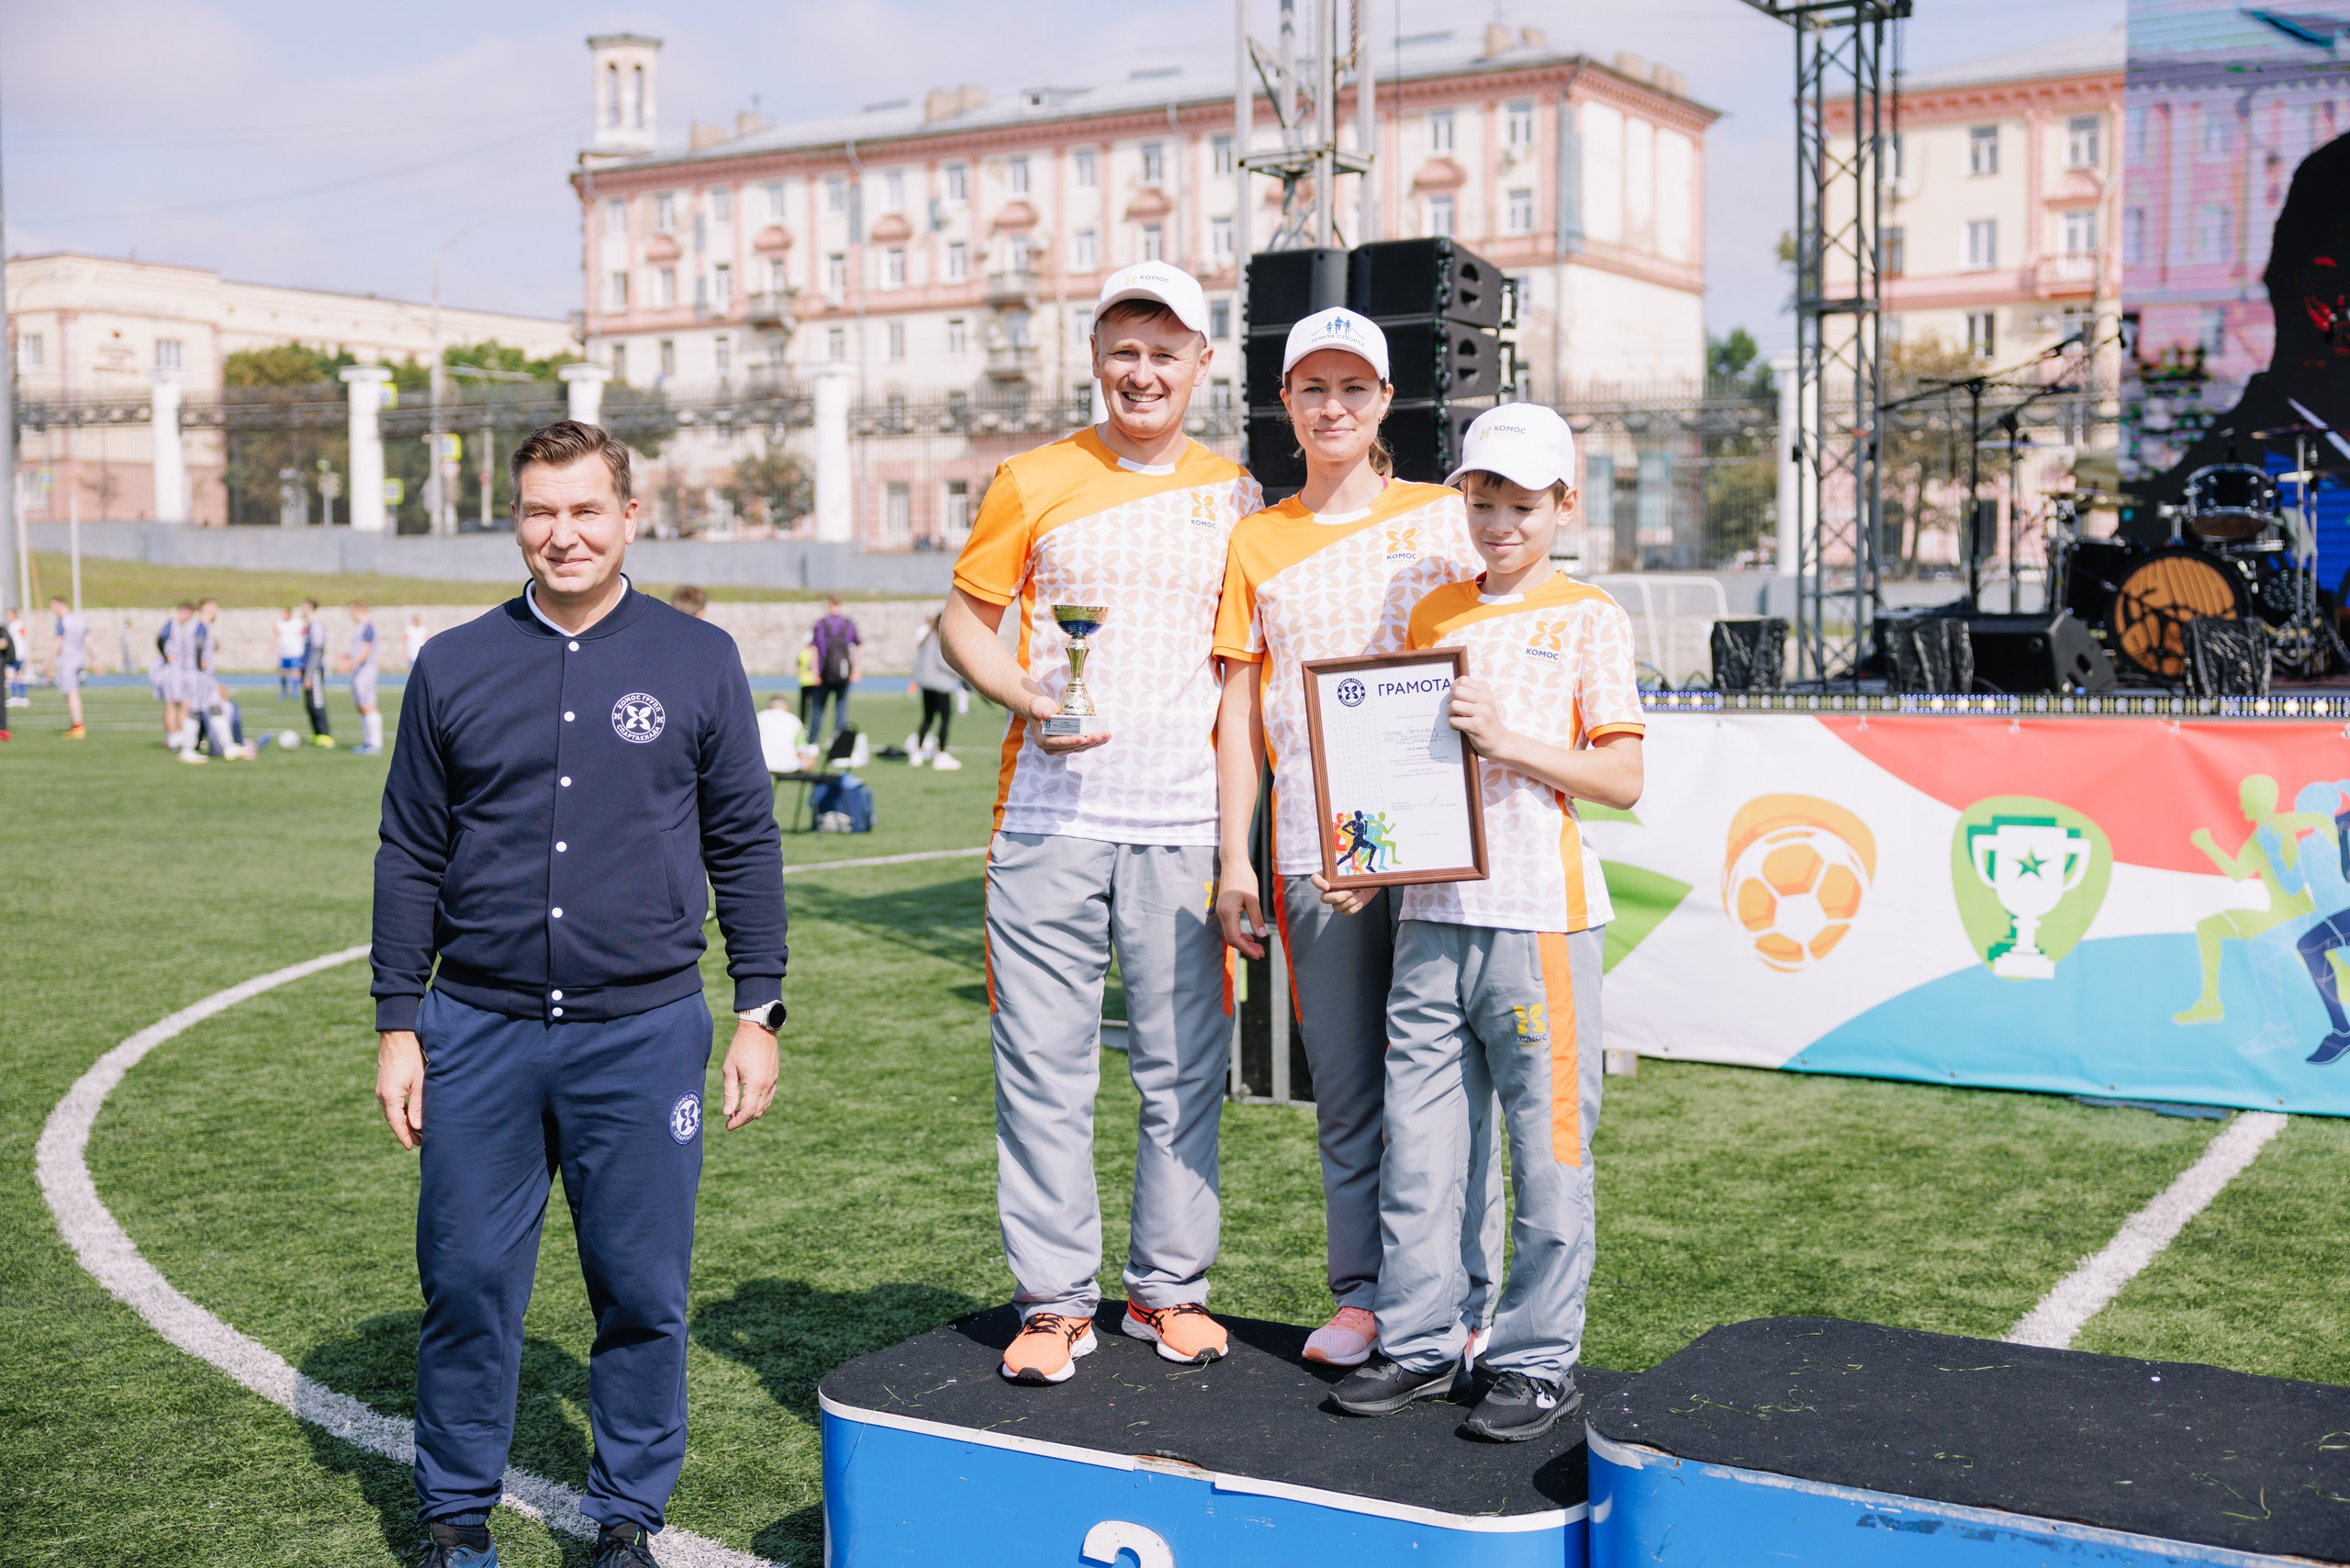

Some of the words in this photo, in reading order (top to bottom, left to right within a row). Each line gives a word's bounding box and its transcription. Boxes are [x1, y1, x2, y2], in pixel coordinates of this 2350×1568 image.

[1139, 274, 1170, 284] КОМОС
[1311, 334, 1335, 343] ЗЕМЛЯ
[1337, 334, 1365, 348] СПОРТА
[1494, 425, 1527, 434] КОМОС
[1191, 519, 1216, 529] КОМОС
[1526, 647, 1560, 660] КОМОС
[1378, 678, 1450, 696] ГРАМОТА
[617, 694, 642, 710] КОМОС
[642, 695, 662, 712] ГРУПП
[616, 724, 661, 742] СПАРТАКИАДА
[1518, 1034, 1548, 1043] КОМОС
[673, 1094, 688, 1115] КОМОС
